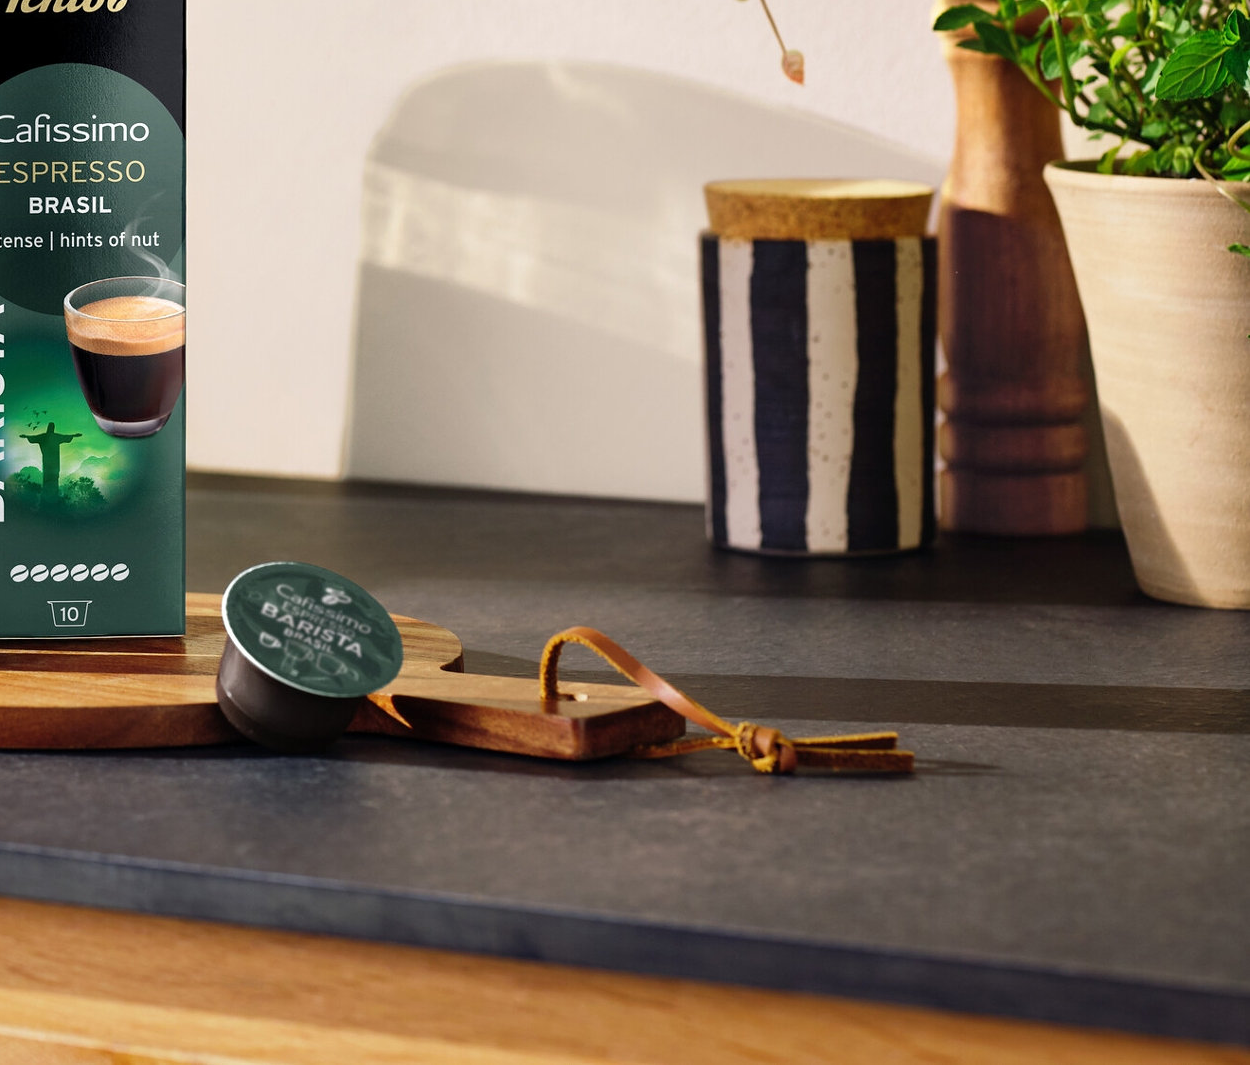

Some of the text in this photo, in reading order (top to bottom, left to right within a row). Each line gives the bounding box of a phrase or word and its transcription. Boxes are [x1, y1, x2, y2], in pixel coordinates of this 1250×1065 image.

[29, 196, 112, 214] BRASIL
[61, 232, 103, 248] hints
[110, 231, 126, 247] of
[131, 232, 160, 247] nut
[60, 607, 78, 622] 10
[276, 584, 372, 635] Cafissimo
[281, 601, 356, 637] ESPRESSO
[260, 602, 363, 659] BARISTA
[284, 628, 334, 654] BRASIL
